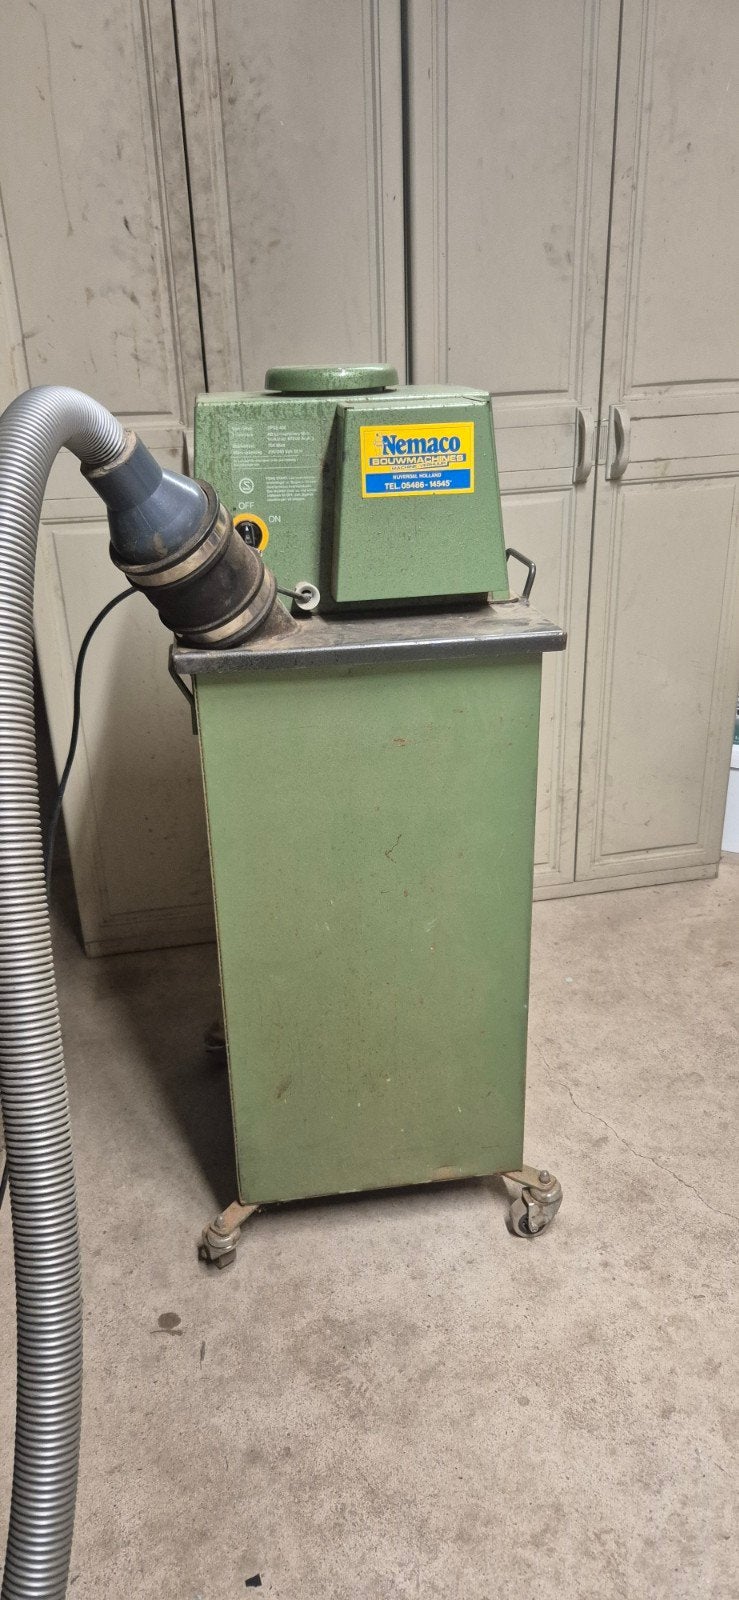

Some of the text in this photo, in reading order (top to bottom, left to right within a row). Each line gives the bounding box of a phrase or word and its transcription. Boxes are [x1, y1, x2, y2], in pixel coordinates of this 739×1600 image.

[382, 434, 461, 456] Nemaco
[372, 454, 464, 466] BOUWMACHINES
[238, 502, 255, 511] OFF
[268, 515, 281, 523] ON
